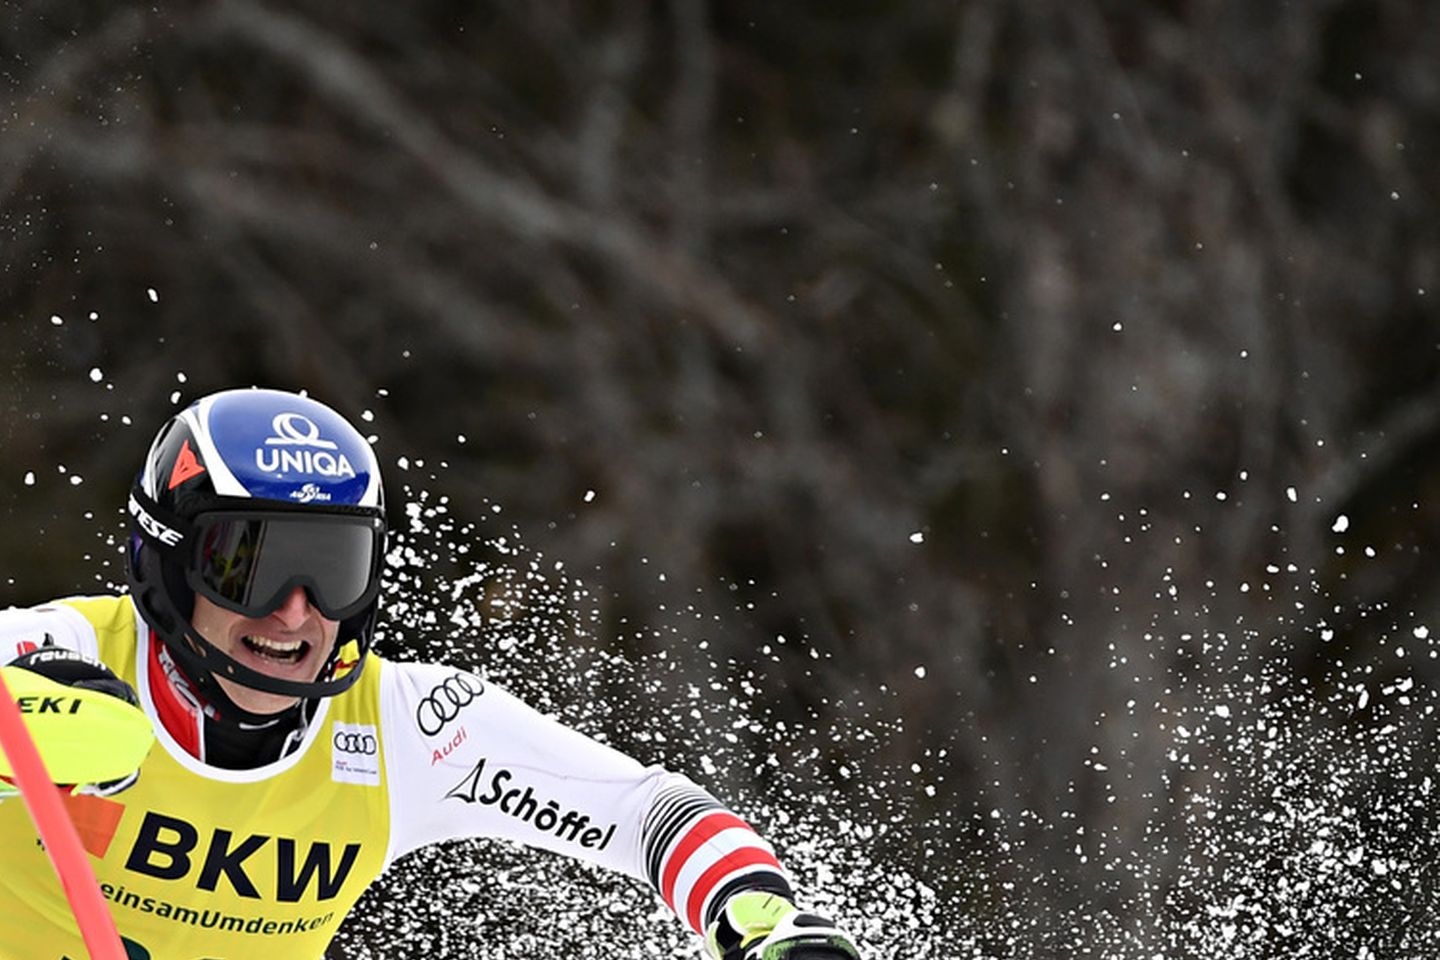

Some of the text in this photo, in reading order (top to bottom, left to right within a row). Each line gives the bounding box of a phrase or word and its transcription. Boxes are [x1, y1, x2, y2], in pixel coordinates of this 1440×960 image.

[255, 447, 357, 479] UNIQA
[128, 492, 185, 547] NESE
[17, 697, 82, 714] EKI
[431, 726, 468, 766] Audi
[480, 769, 617, 851] Schöffel
[125, 811, 362, 903] BKW
[100, 880, 334, 935] einsamUmdenken
